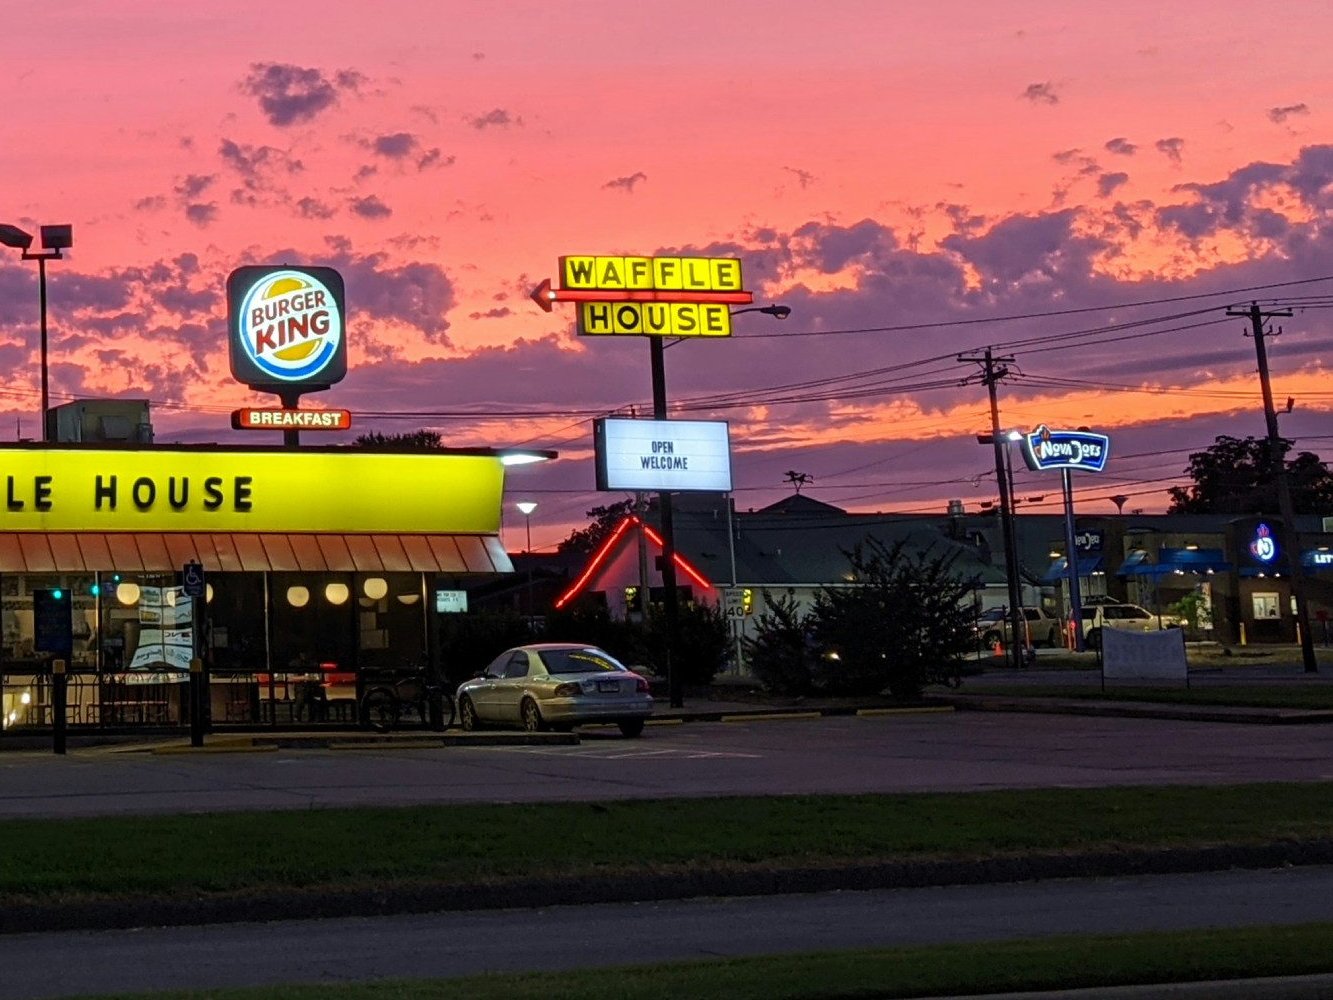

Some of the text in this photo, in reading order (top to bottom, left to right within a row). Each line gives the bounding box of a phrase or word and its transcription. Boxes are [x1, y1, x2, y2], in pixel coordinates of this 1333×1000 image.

[569, 260, 734, 287] WAFFLE
[251, 289, 327, 329] BURGER
[589, 305, 723, 332] HOUSE
[255, 310, 331, 355] KING
[249, 411, 342, 426] BREAKFAST
[651, 440, 674, 454] OPEN
[640, 456, 689, 470] WELCOME
[94, 474, 253, 511] HOUSE
[727, 606, 744, 617] 40
